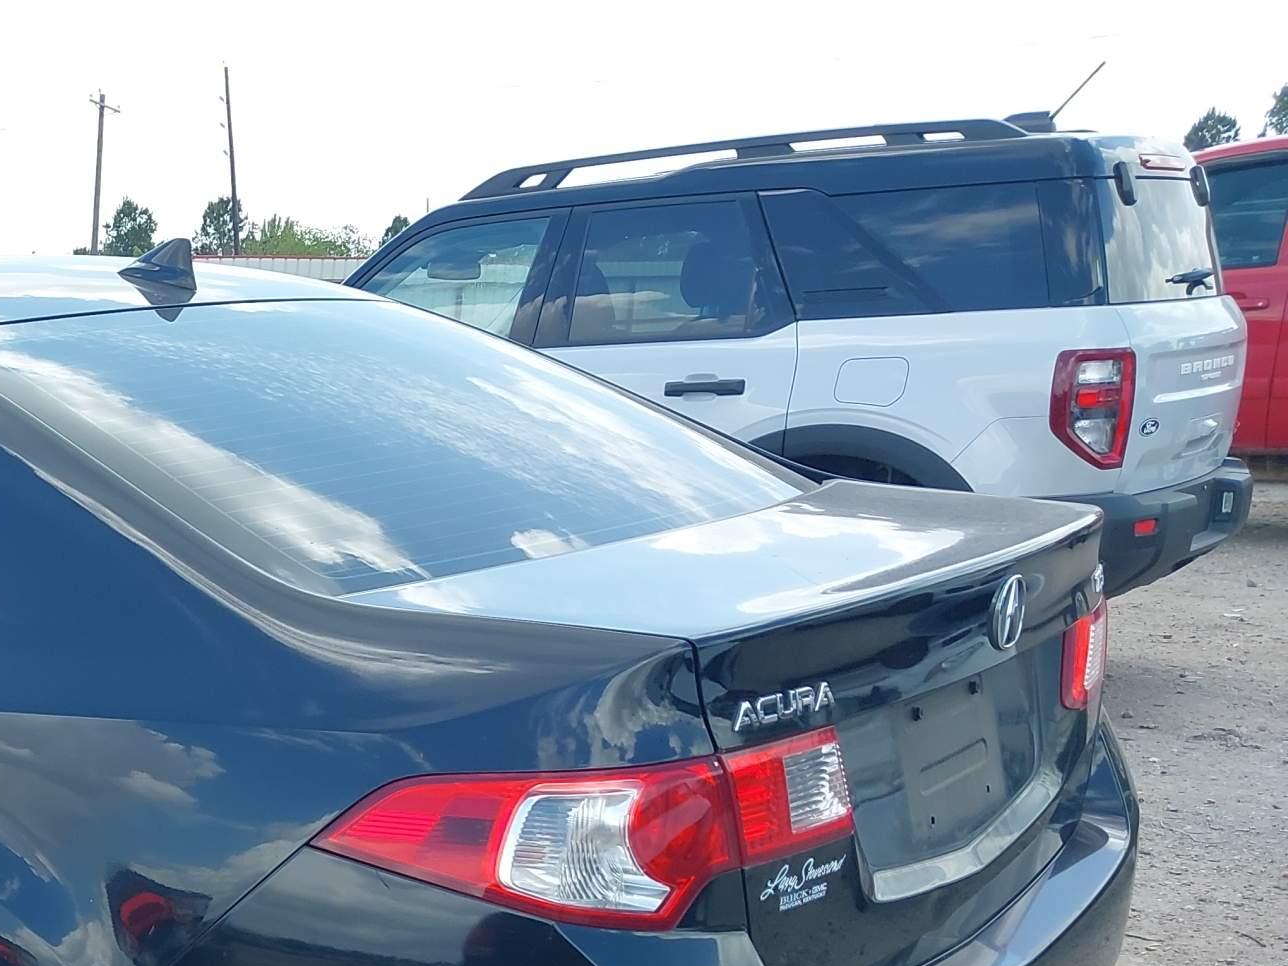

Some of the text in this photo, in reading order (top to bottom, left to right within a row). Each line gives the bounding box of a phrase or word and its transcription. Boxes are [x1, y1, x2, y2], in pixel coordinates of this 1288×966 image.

[1180, 355, 1235, 376] BRONCO
[733, 681, 836, 732] ACURA
[780, 889, 810, 905] BUICK
